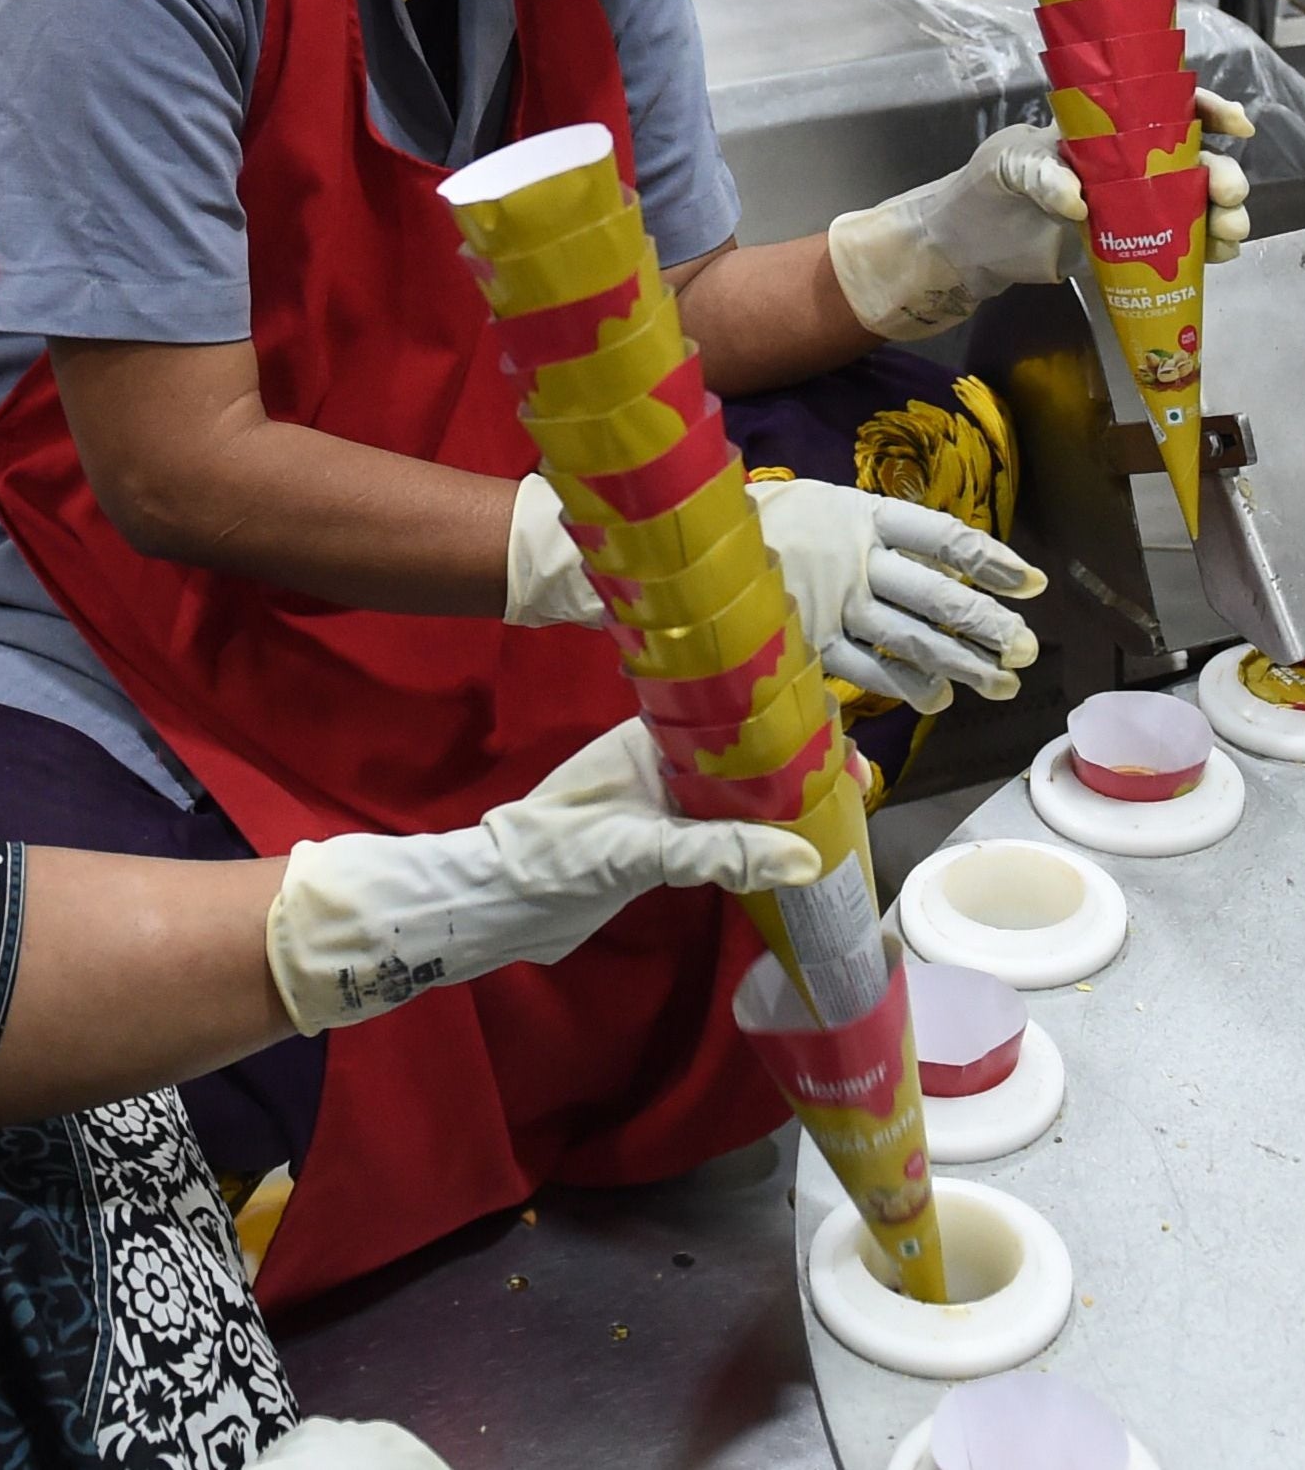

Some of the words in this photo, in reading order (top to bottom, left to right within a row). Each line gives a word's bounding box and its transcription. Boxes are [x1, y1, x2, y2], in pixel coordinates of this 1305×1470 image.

[1099, 228, 1173, 250] Havmor
[1132, 248, 1158, 257] CREAM
[1156, 285, 1196, 306] PISTA
